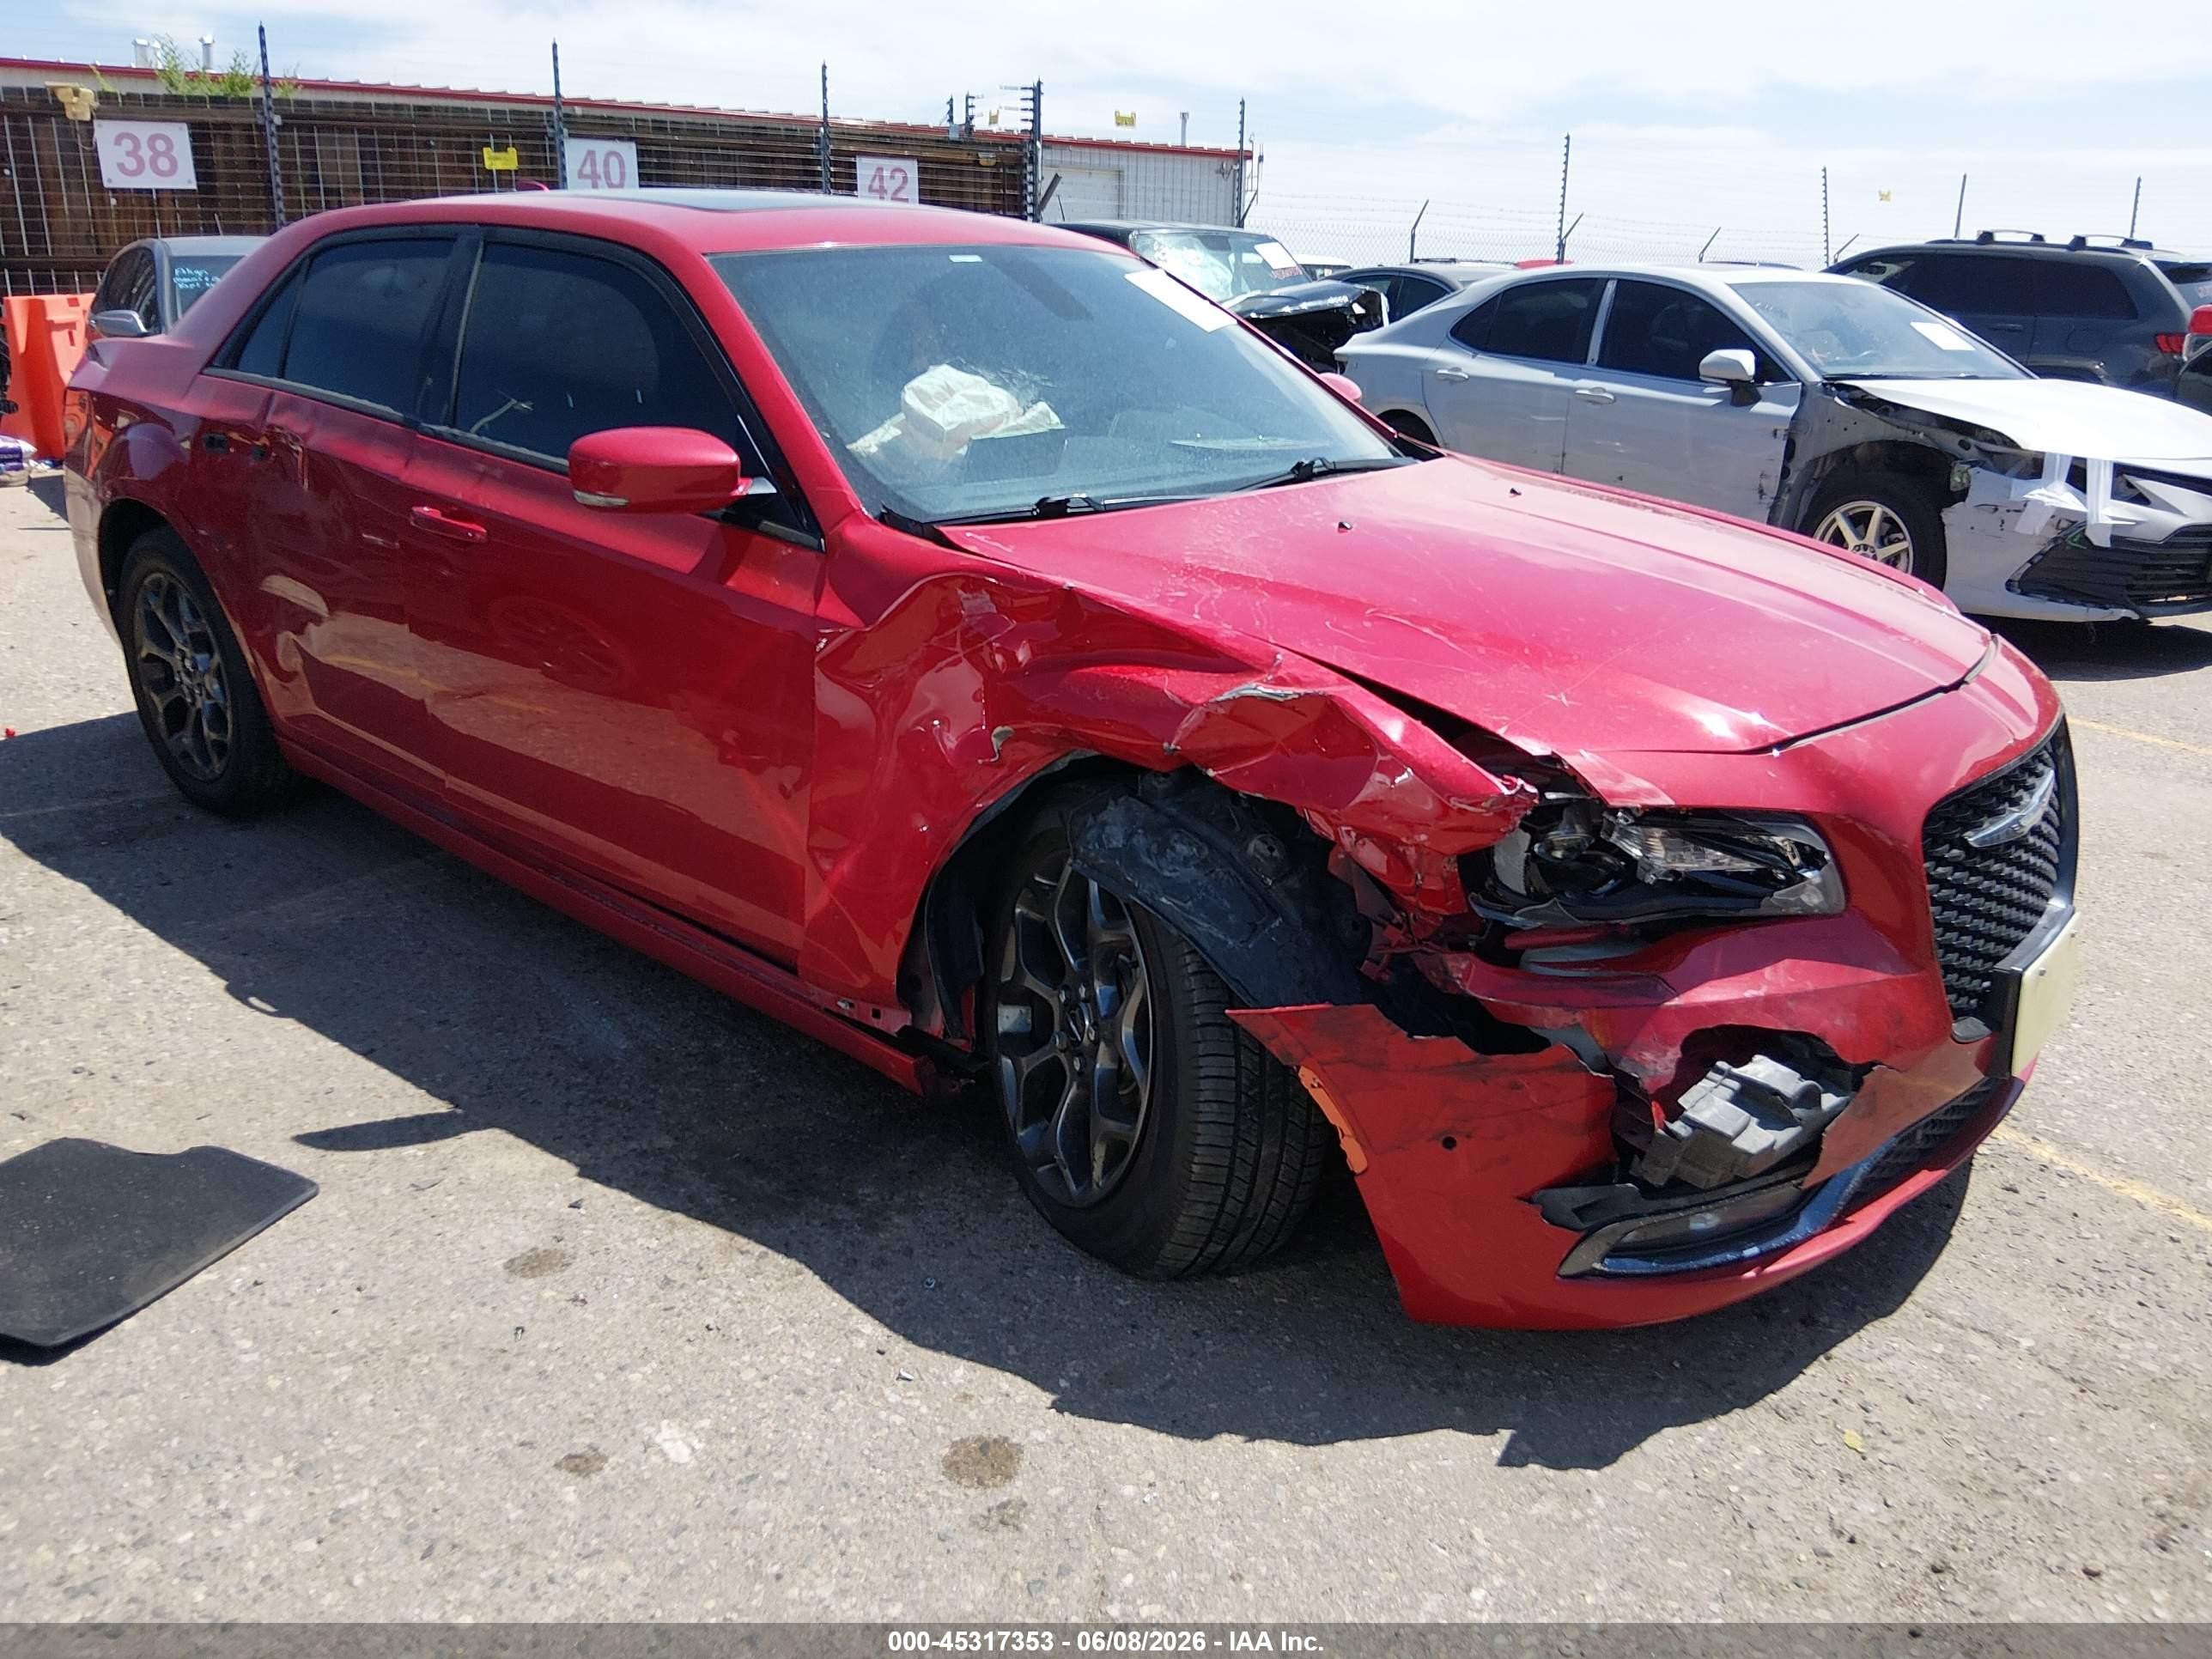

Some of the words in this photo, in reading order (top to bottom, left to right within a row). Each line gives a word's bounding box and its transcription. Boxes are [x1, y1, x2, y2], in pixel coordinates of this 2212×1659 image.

[114, 132, 179, 178] 38
[577, 150, 626, 189] 40
[868, 167, 909, 203] 42
